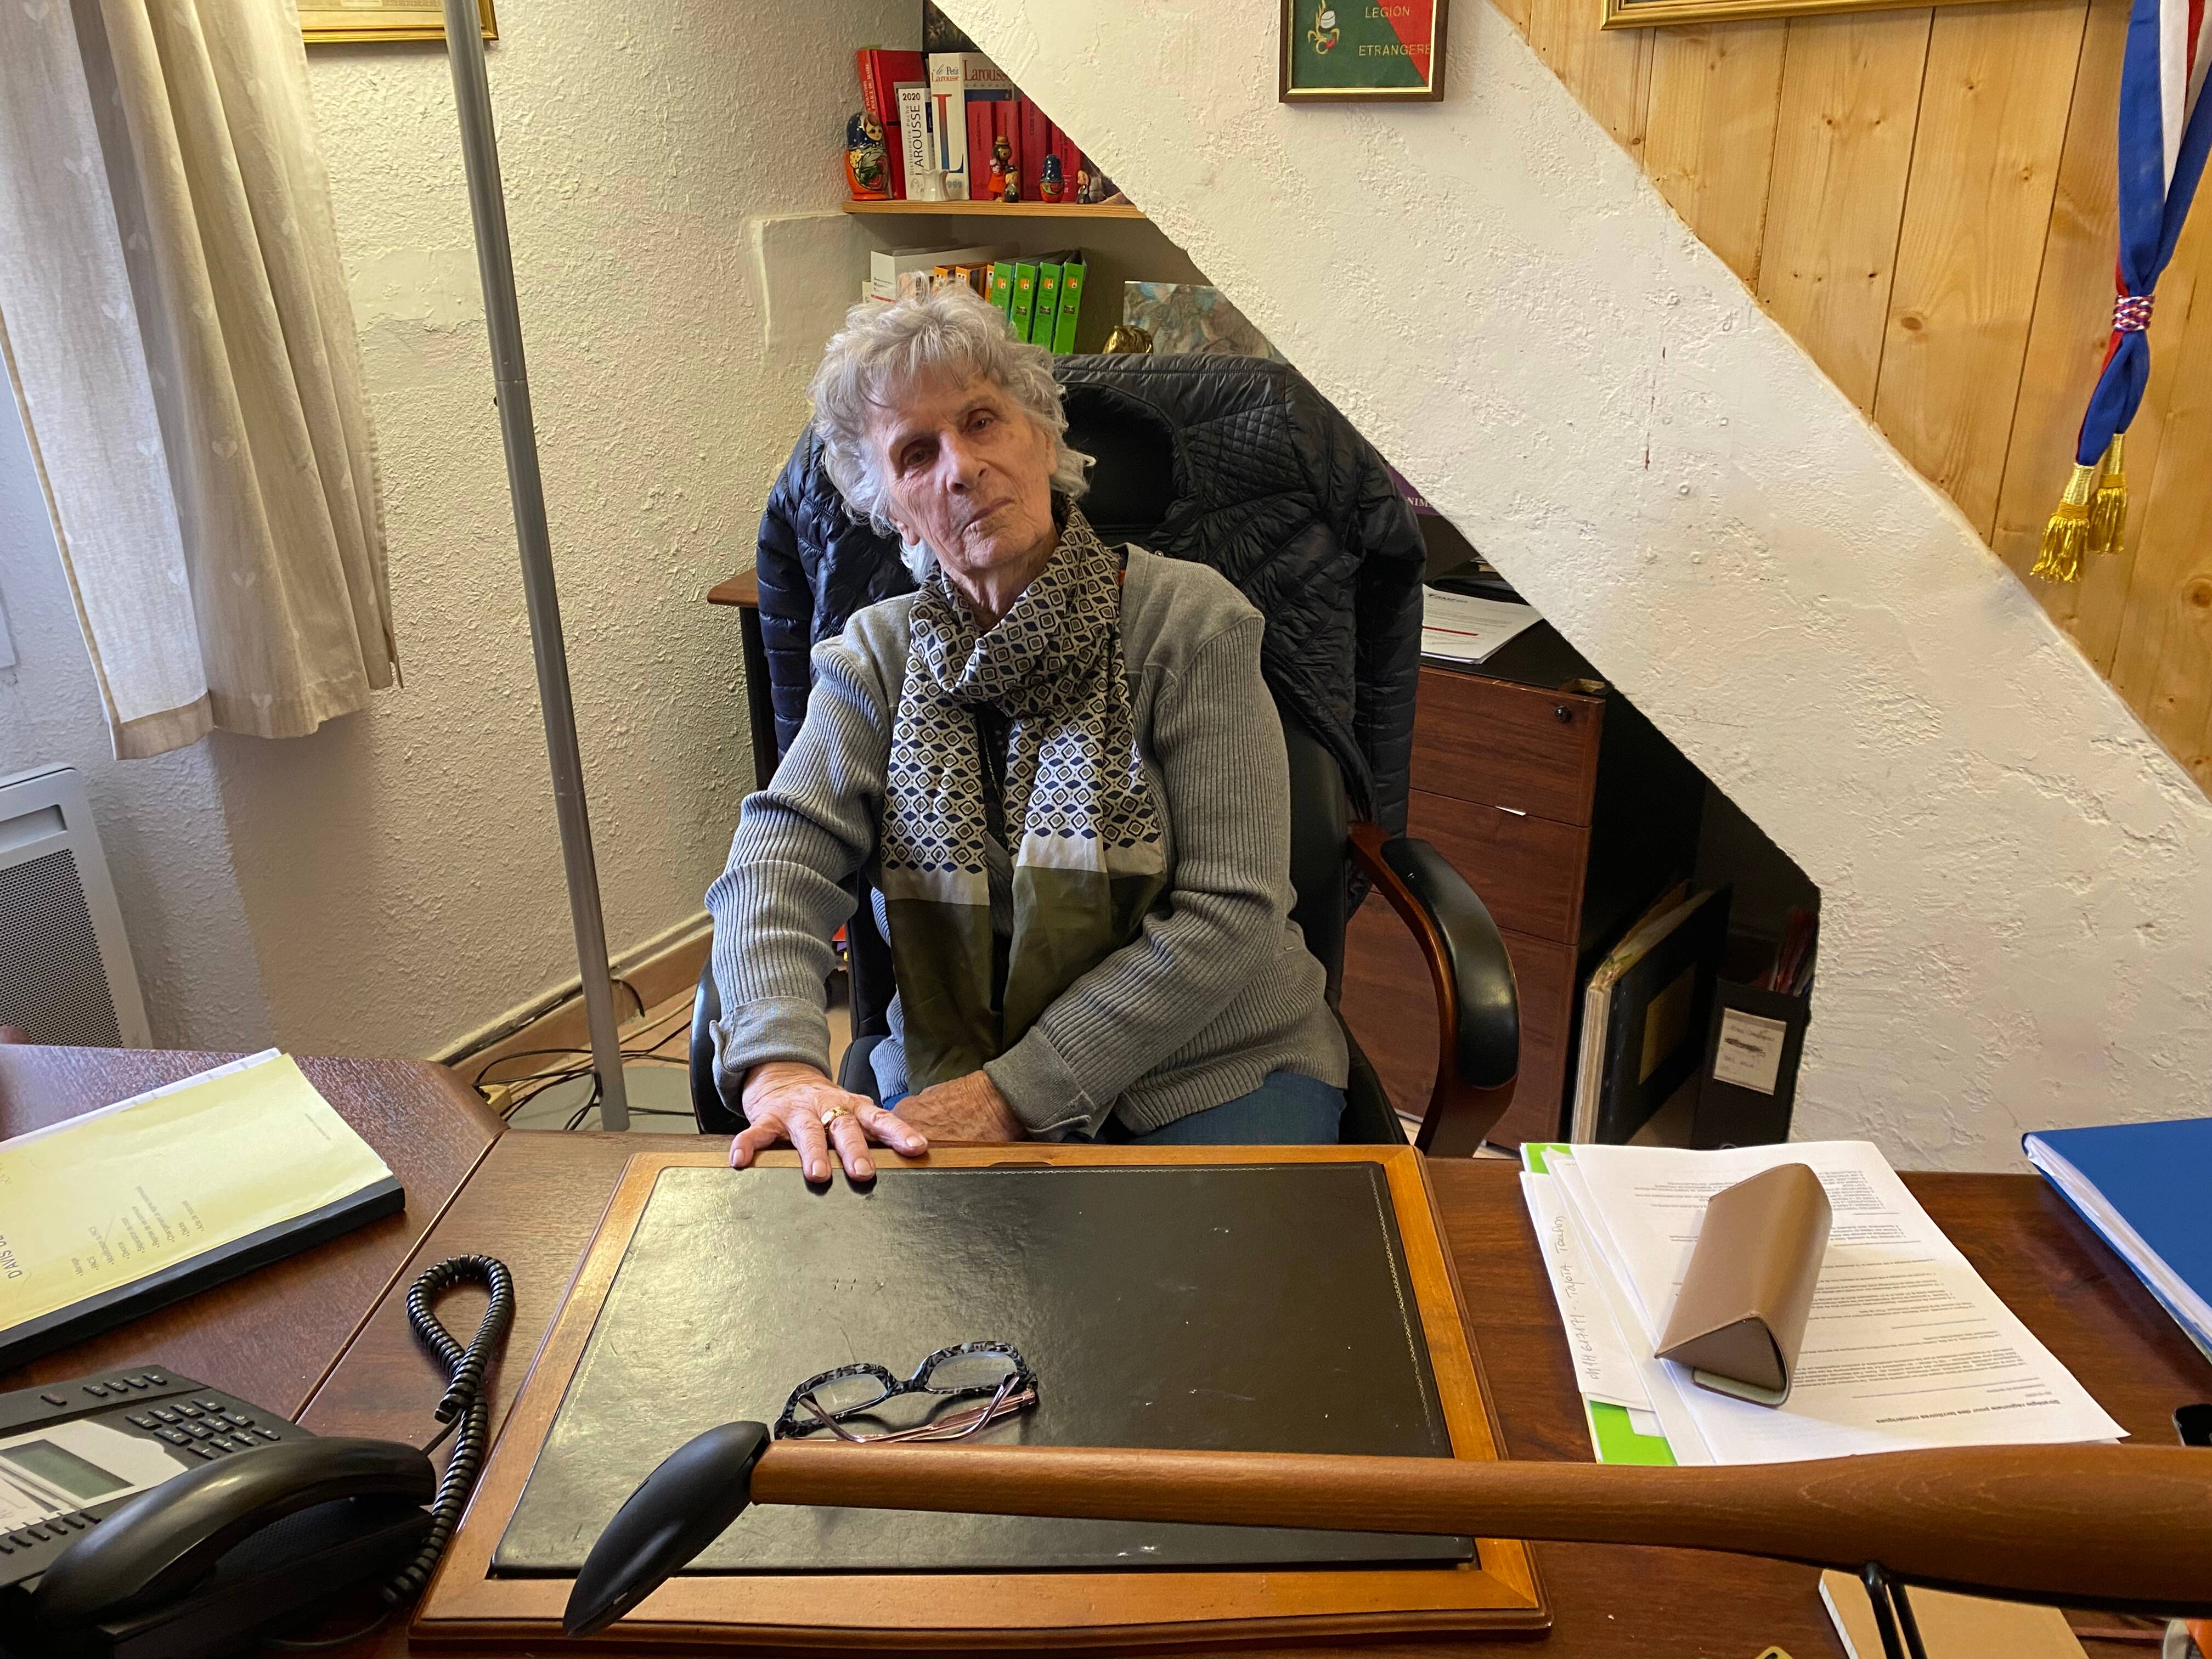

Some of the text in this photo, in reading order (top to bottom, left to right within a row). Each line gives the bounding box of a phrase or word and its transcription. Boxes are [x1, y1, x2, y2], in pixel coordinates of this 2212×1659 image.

[1365, 6, 1411, 18] LEGION
[1358, 43, 1431, 57] ETRANGERE
[946, 66, 959, 75] Petit
[932, 73, 959, 82] Larousse
[932, 94, 964, 173] L
[910, 105, 924, 176] LAROUSSE
[87, 1256, 99, 1269] PACS
